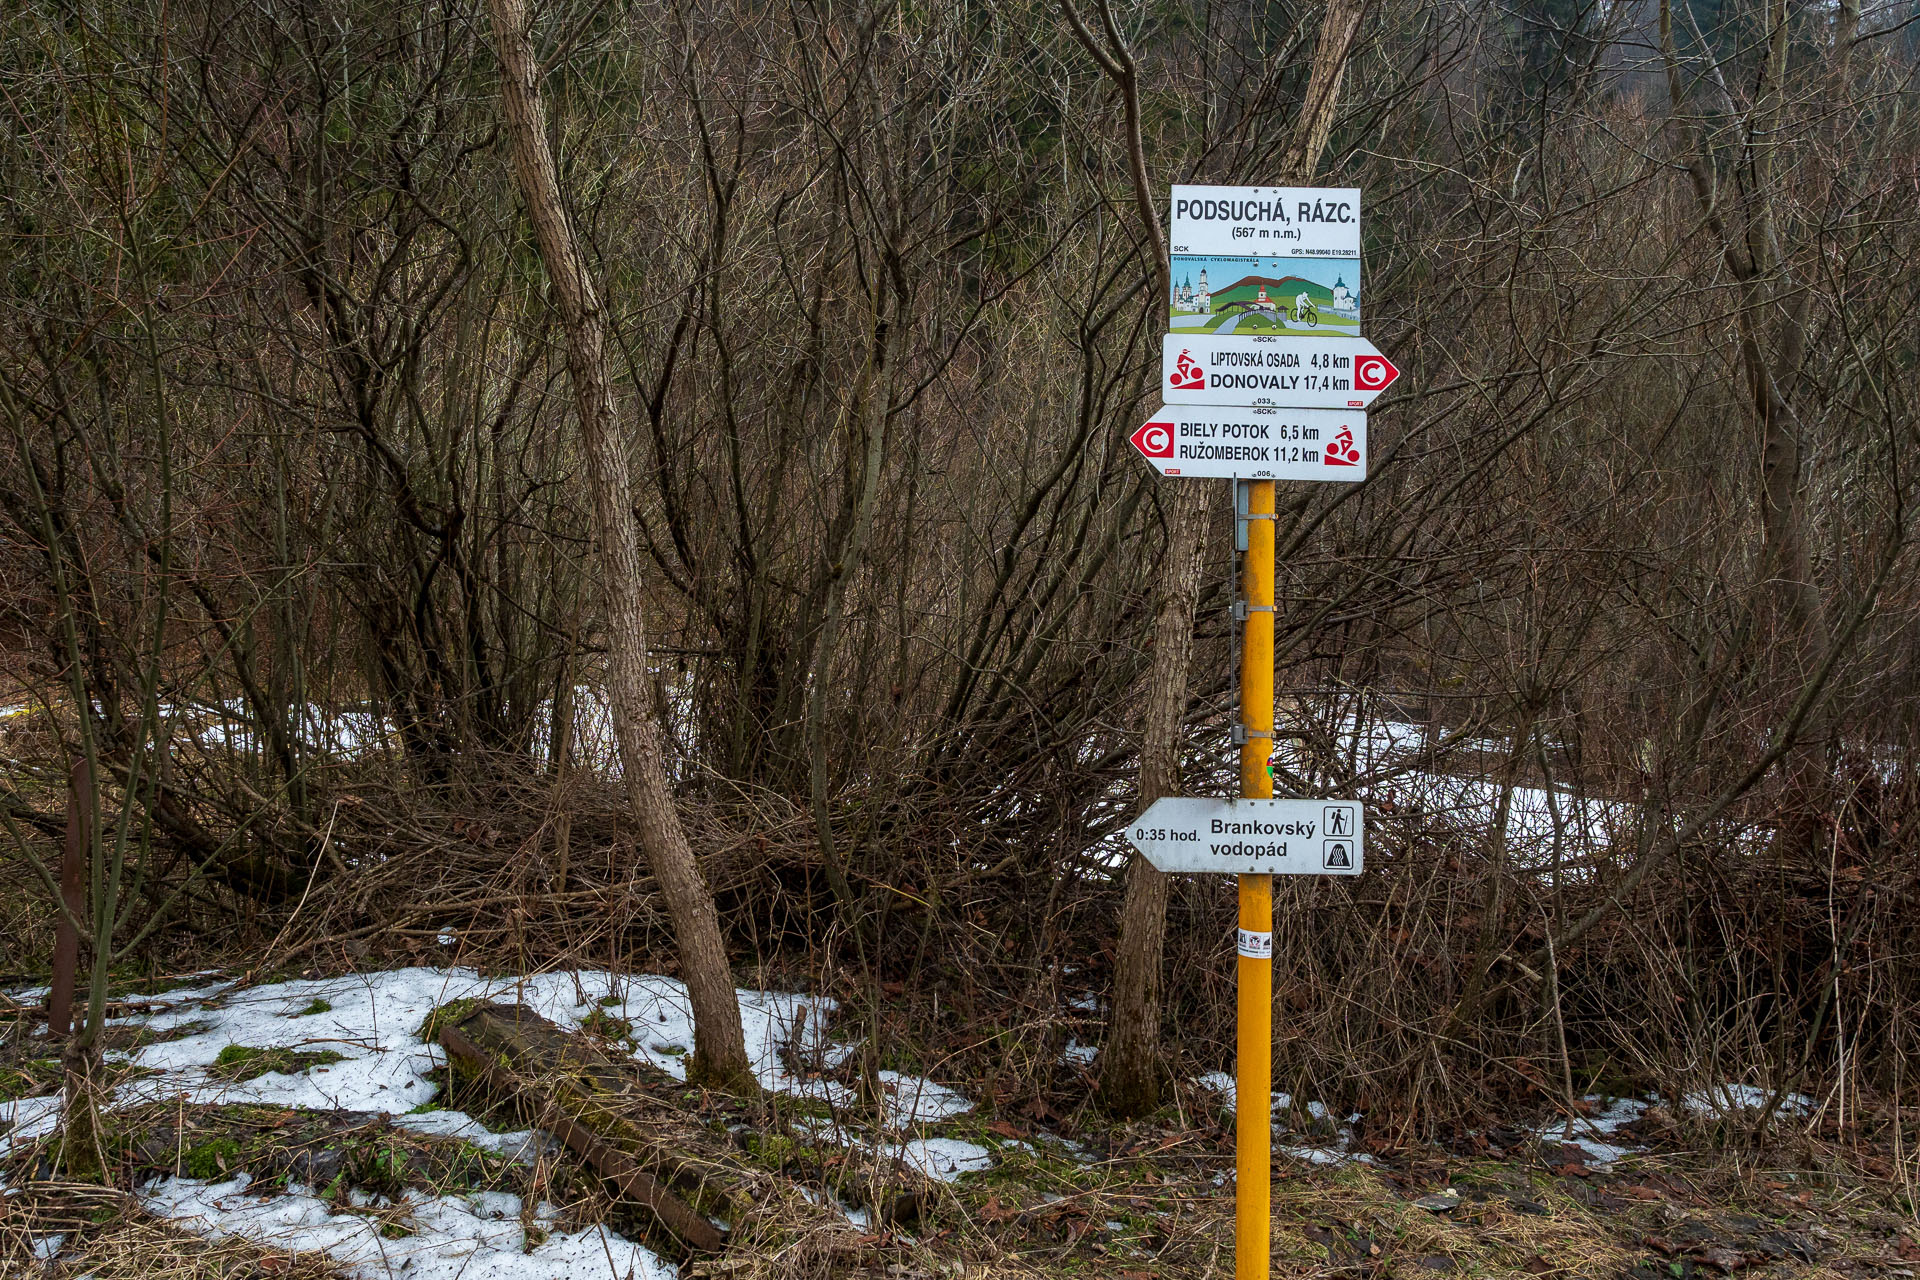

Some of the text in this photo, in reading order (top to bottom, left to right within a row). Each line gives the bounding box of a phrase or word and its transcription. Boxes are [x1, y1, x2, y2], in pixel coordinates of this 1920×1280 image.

[1176, 197, 1356, 226] PODSUCHÁ, RÁZC.
[1231, 227, 1302, 241] (567 m n.m.)
[1210, 349, 1350, 371] LIPTOVSKÁ OSADA 4,8 km
[1210, 374, 1350, 393] DONOVALY 17,4 km
[1180, 422, 1319, 441] BIELY POTOK 6,5 km
[1179, 441, 1319, 464] RUŽOMBEROK 11,2 km
[1136, 828, 1201, 841] 0:35 hod.
[1211, 819, 1316, 839] Brankovský
[1210, 841, 1287, 860] vodopád
